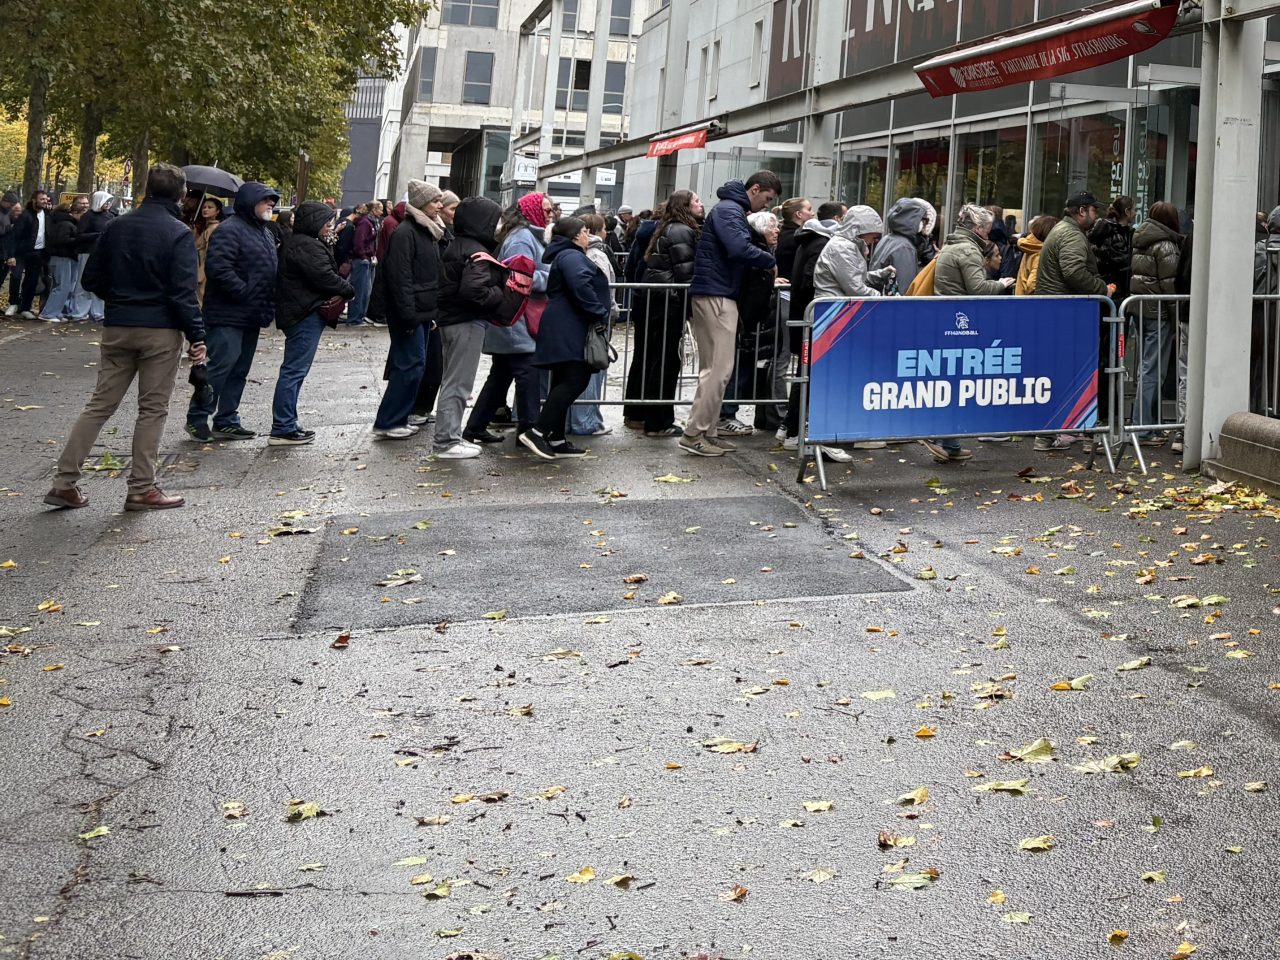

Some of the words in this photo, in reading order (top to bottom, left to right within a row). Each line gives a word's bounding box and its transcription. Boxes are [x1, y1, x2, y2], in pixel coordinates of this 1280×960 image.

[1001, 53, 1041, 74] PARTENAIRE
[1039, 51, 1049, 67] DE
[1048, 49, 1057, 66] LA
[1056, 46, 1071, 64] SIG
[1071, 33, 1128, 60] STRASBOURG
[896, 339, 1023, 378] ENTRÉE
[862, 380, 952, 411] GRAND
[958, 376, 1052, 407] PUBLIC
